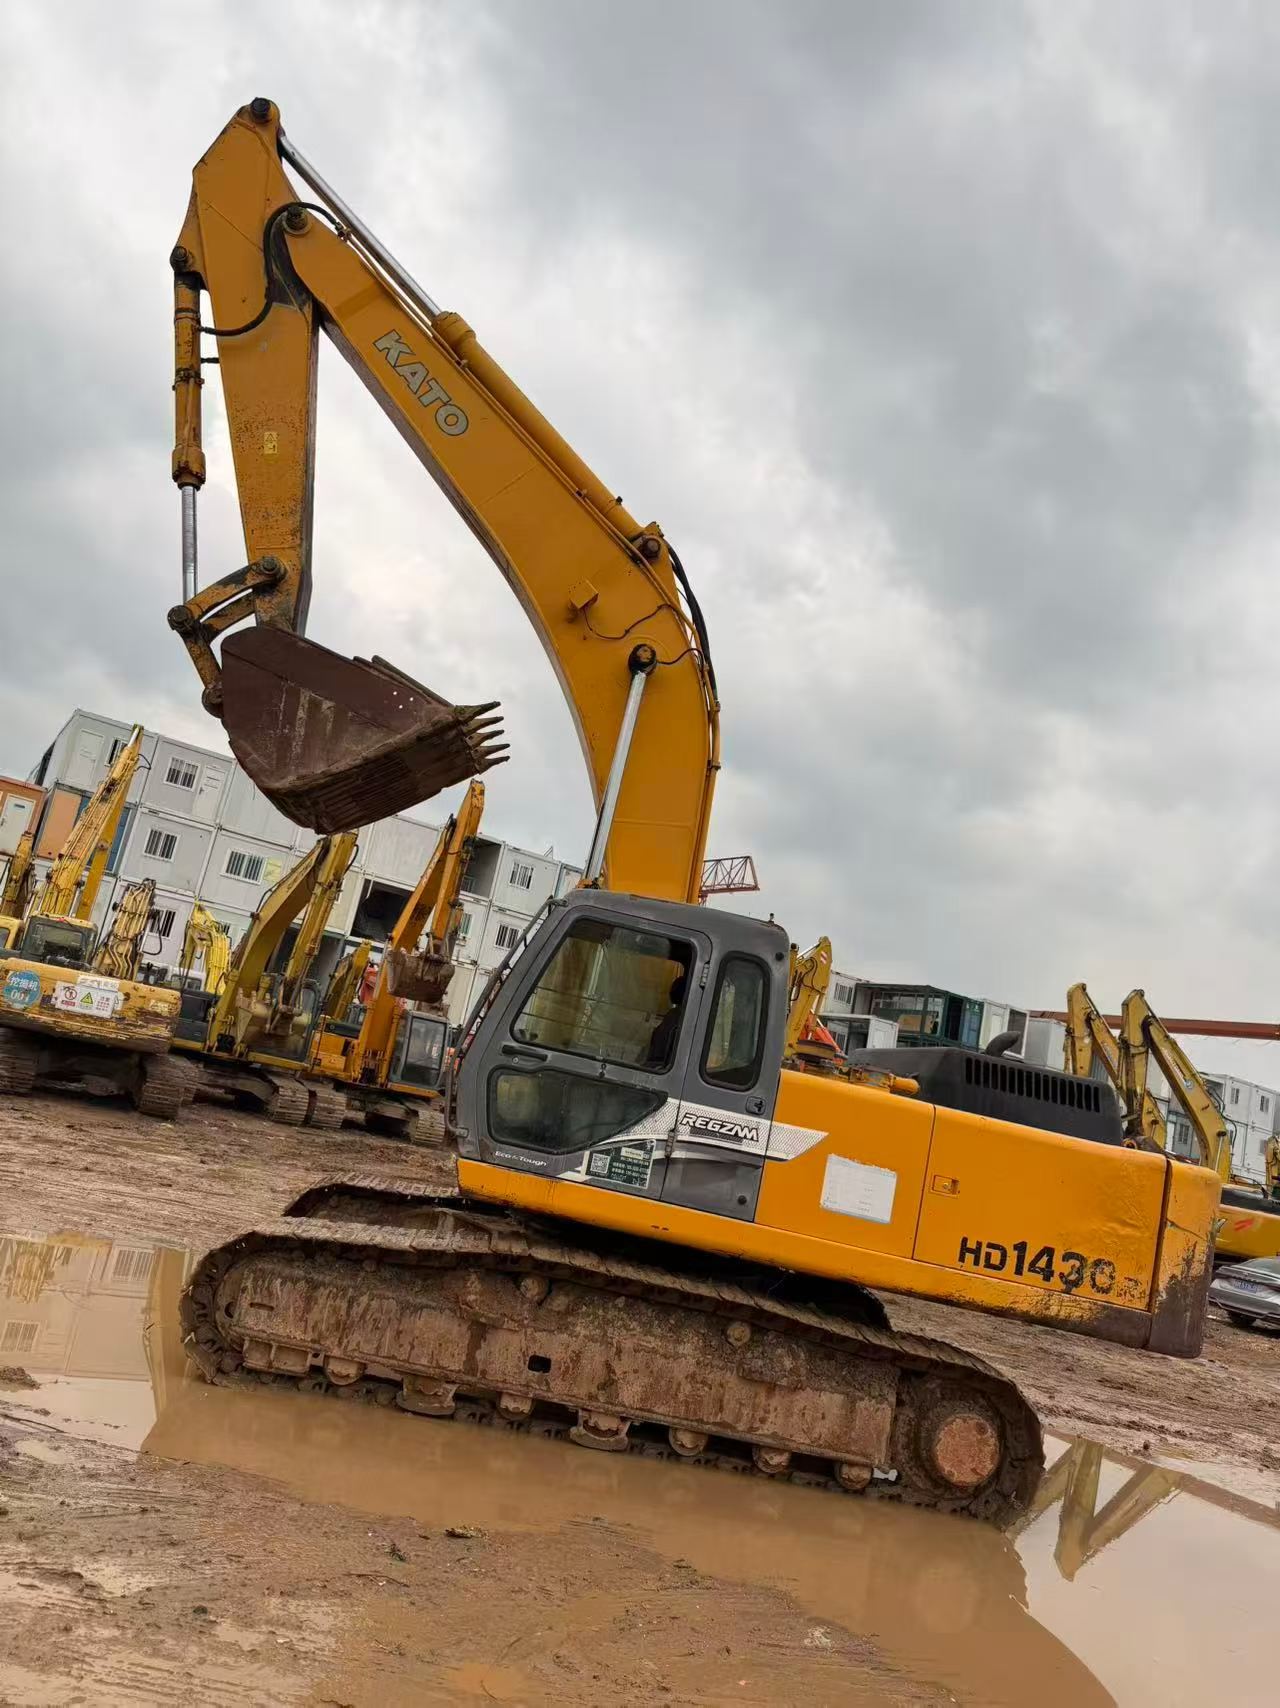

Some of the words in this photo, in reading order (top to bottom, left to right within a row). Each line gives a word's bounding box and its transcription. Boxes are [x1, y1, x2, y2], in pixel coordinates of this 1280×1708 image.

[373, 329, 469, 436] KATO
[9, 977, 38, 991] 挖掘机
